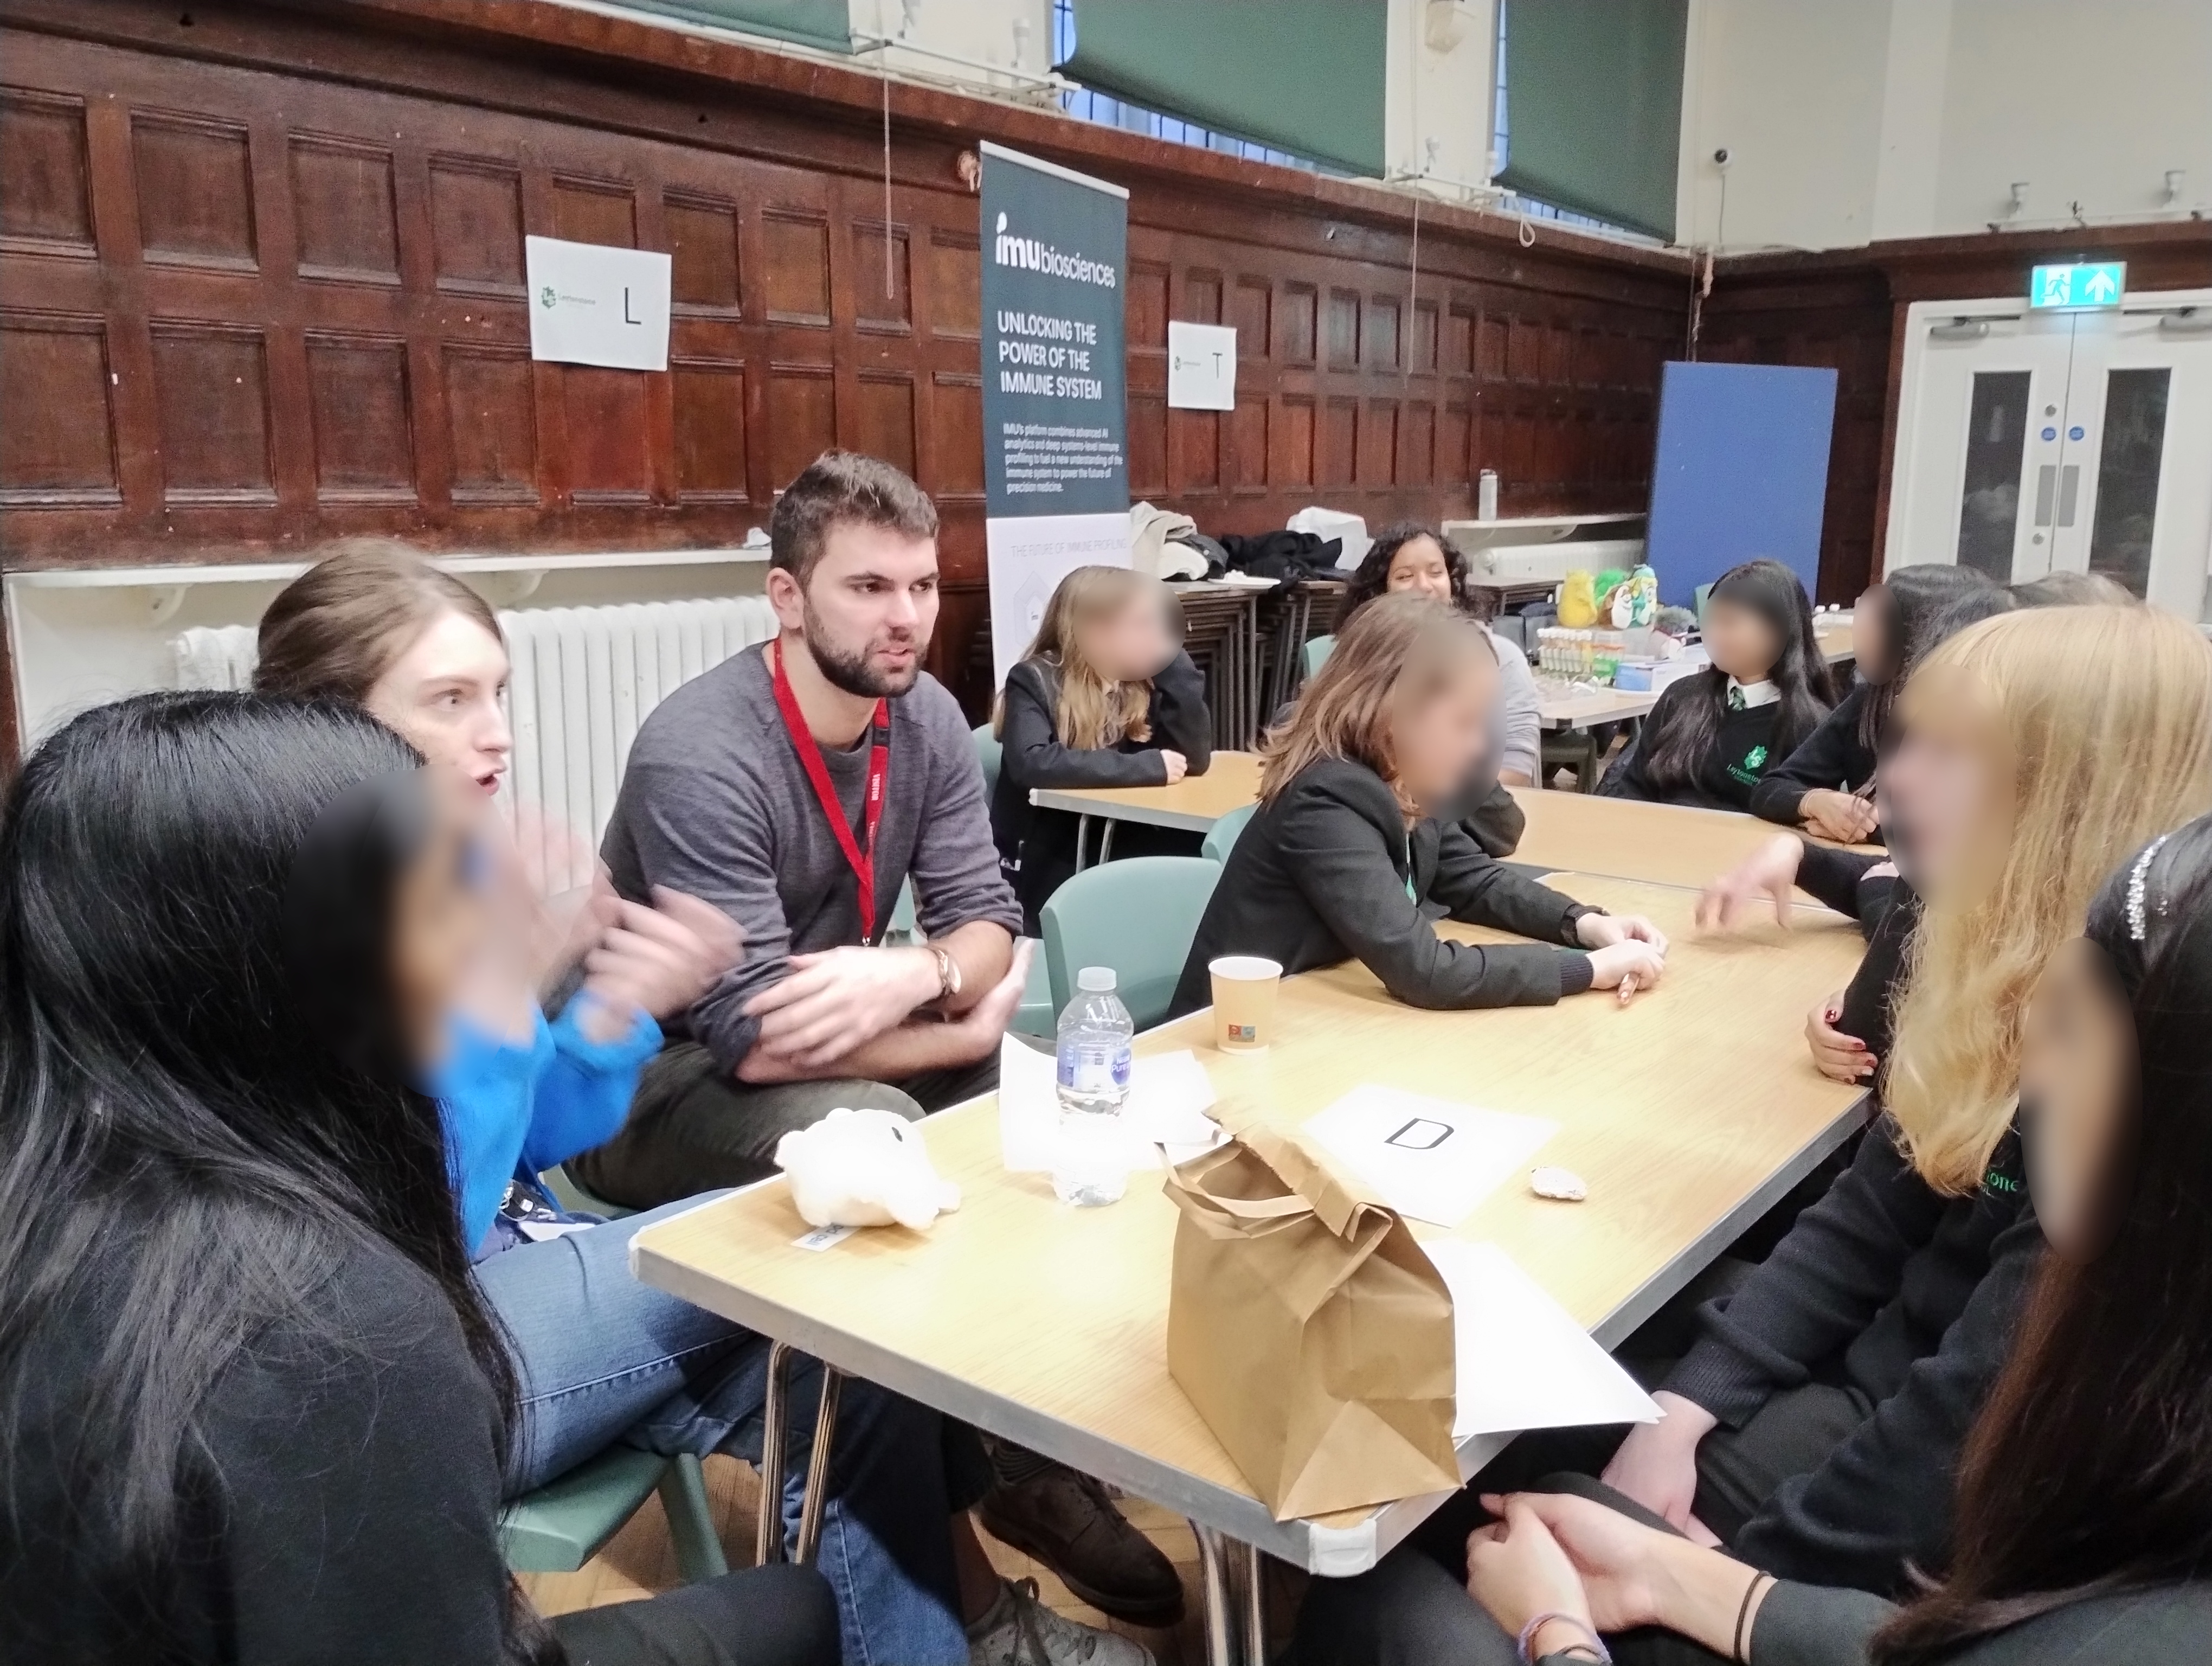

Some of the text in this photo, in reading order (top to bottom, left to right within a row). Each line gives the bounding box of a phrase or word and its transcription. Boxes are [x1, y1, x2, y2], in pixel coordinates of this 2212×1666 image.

[625, 287, 642, 325] L
[998, 310, 1097, 345] UNLOCKING THE
[999, 340, 1090, 372] POWER OF THE
[1212, 352, 1223, 379] T
[1000, 371, 1102, 401] IMMUNE SYSTEM
[1025, 425, 1047, 437] platform
[1047, 426, 1076, 437] combines
[1004, 439, 1035, 452] analytics
[1035, 439, 1045, 450] and
[1046, 440, 1061, 452] deep
[1098, 442, 1120, 453] immune
[1005, 452, 1033, 466] profiling
[1070, 454, 1107, 467] understanding
[1033, 469, 1053, 480] system
[1053, 468, 1060, 478] to
[1007, 482, 1037, 496] precision
[1011, 544, 1027, 557] THE
[1055, 542, 1065, 554] OF
[1093, 538, 1127, 552] PROFILING
[871, 773, 880, 800] VISITOR
[1384, 1117, 1455, 1150] D
[1987, 1172, 2020, 1192] one
[805, 1234, 828, 1246] cell
